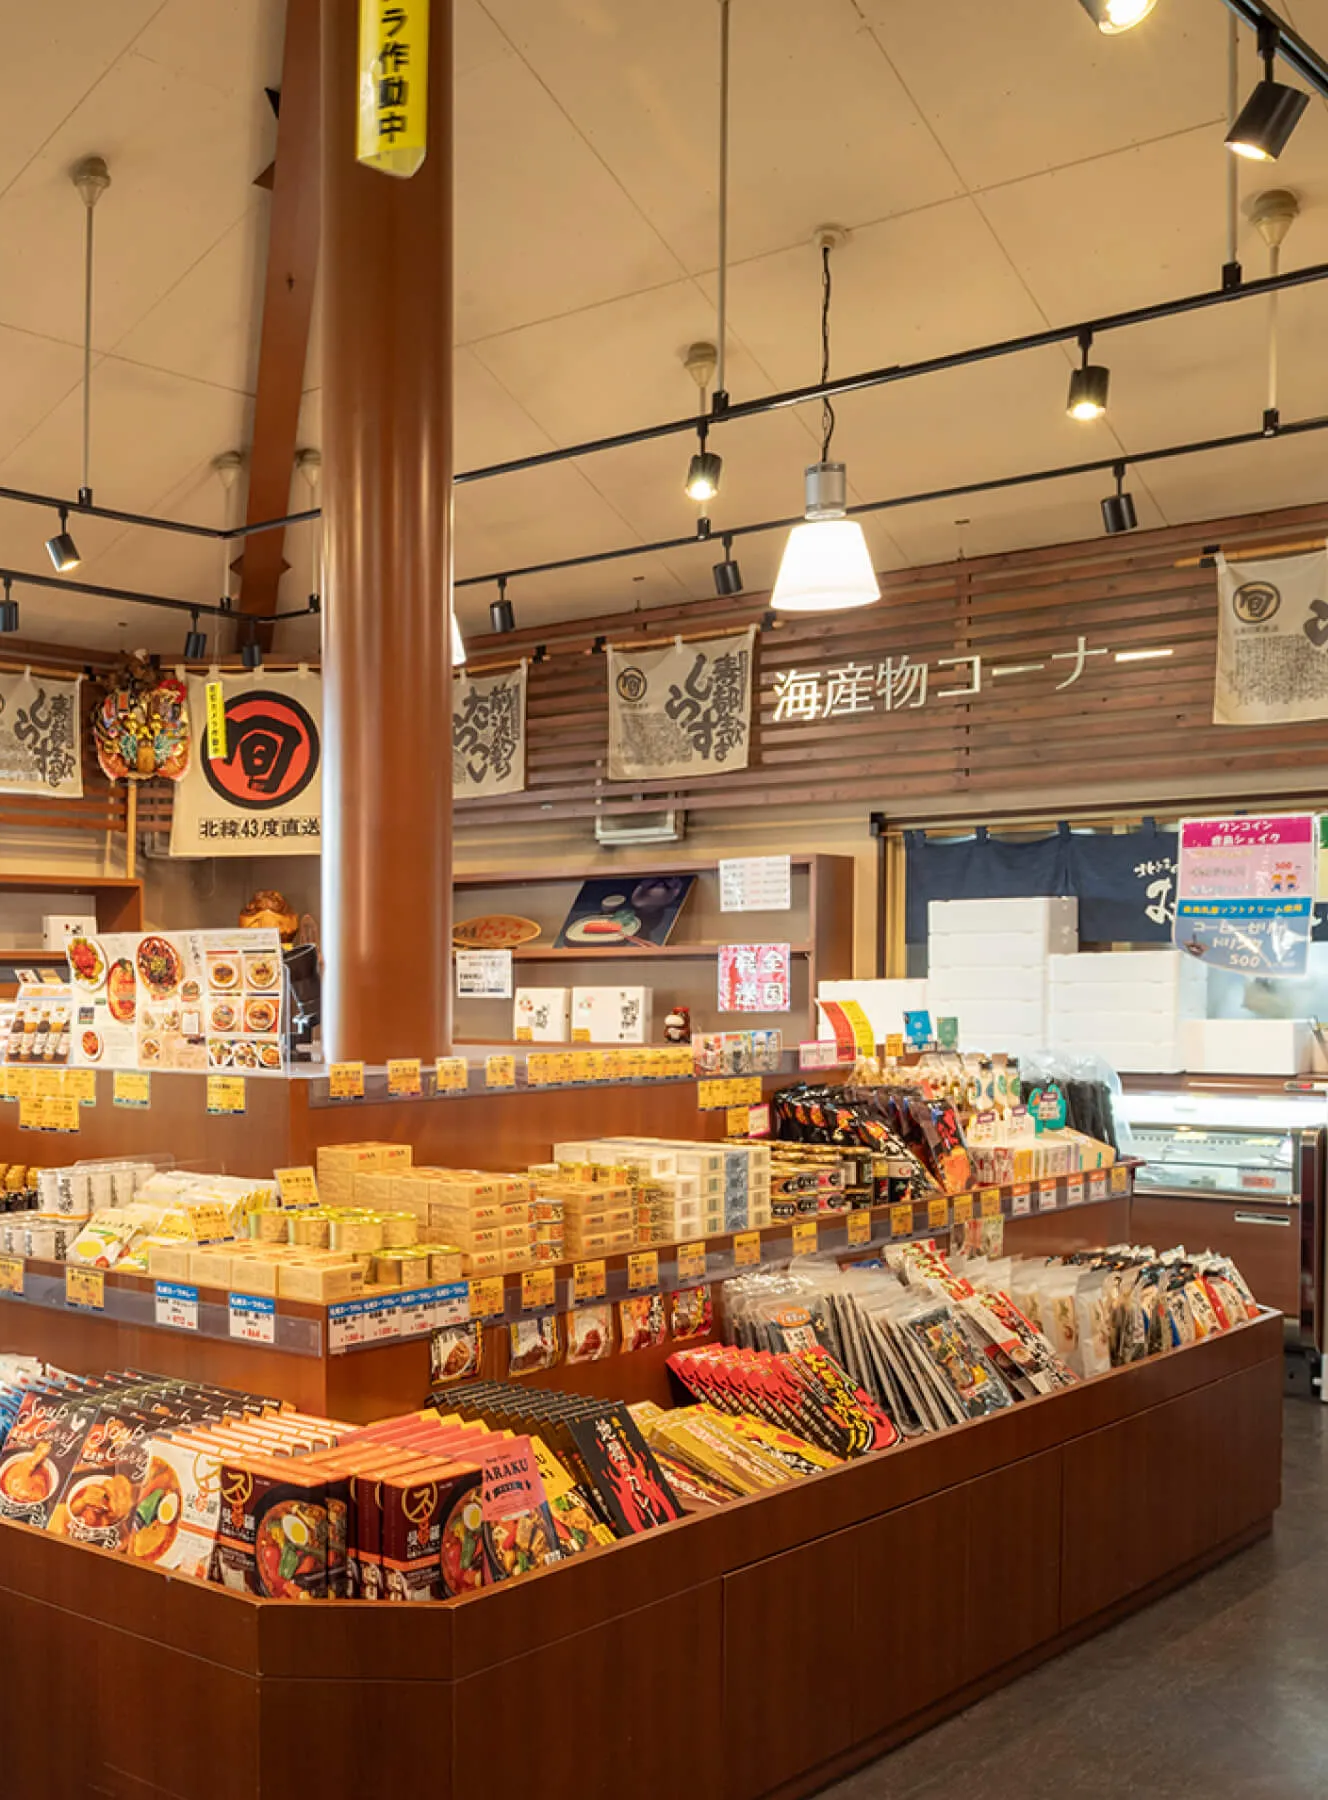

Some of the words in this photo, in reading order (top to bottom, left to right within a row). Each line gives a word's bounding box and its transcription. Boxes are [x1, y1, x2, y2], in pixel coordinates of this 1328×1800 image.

[378, 0, 410, 144] ラ作動中
[772, 635, 1174, 722] 海産物コーナー
[199, 817, 321, 840] 北緯43度直送
